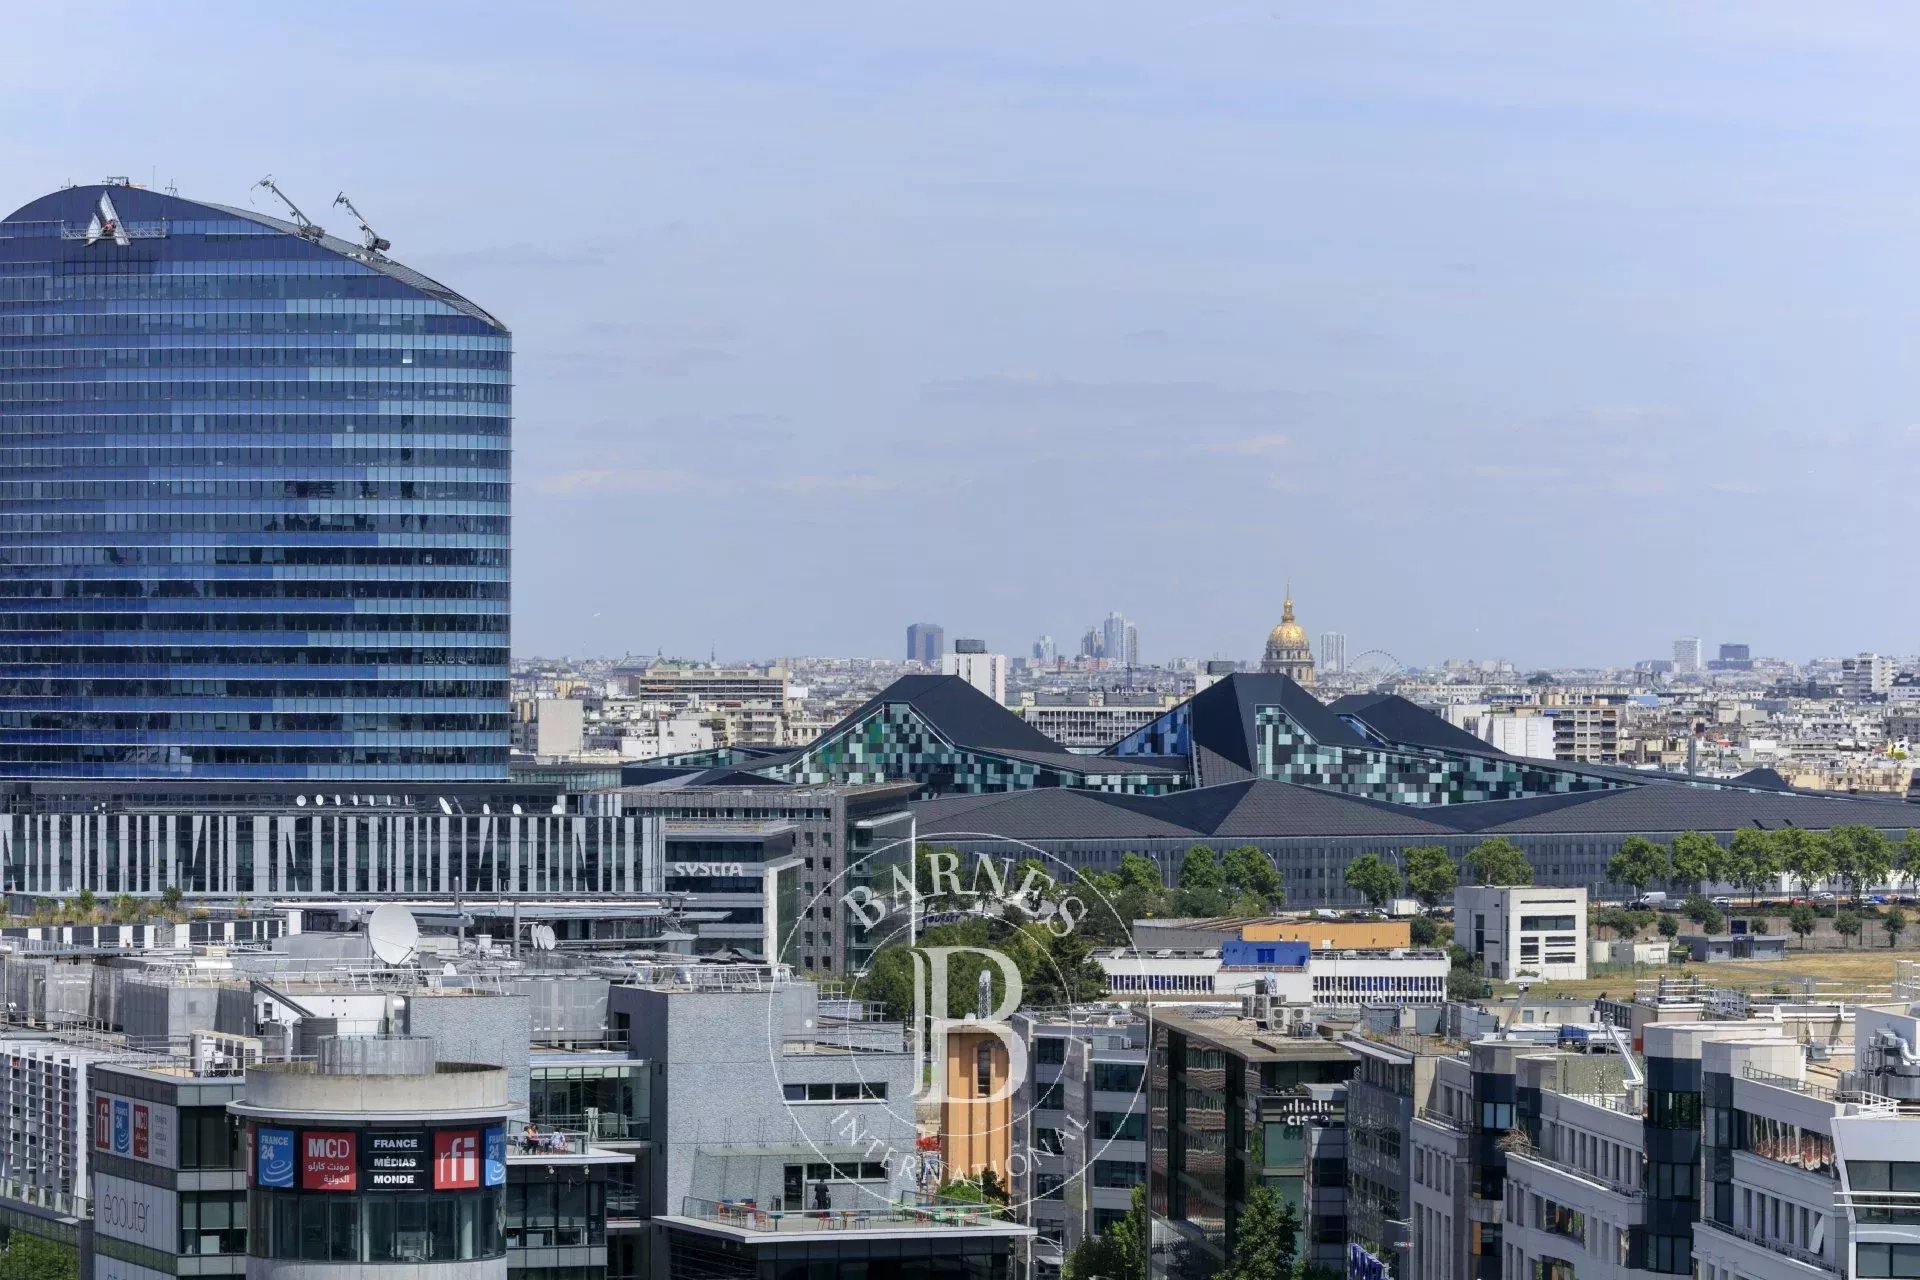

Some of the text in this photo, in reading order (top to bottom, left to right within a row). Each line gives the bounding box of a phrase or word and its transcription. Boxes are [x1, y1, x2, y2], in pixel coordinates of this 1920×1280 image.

[261, 1135, 289, 1146] FRANCE
[374, 1139, 418, 1148] FRANCE
[261, 1145, 275, 1160] 24
[308, 1138, 350, 1158] MCD
[488, 1144, 499, 1159] 24
[374, 1156, 416, 1167] MÉDIAS
[440, 1137, 475, 1182] rfi
[324, 1174, 350, 1185] الدولية
[374, 1175, 415, 1184] MONDE
[103, 1185, 150, 1233] écouter
